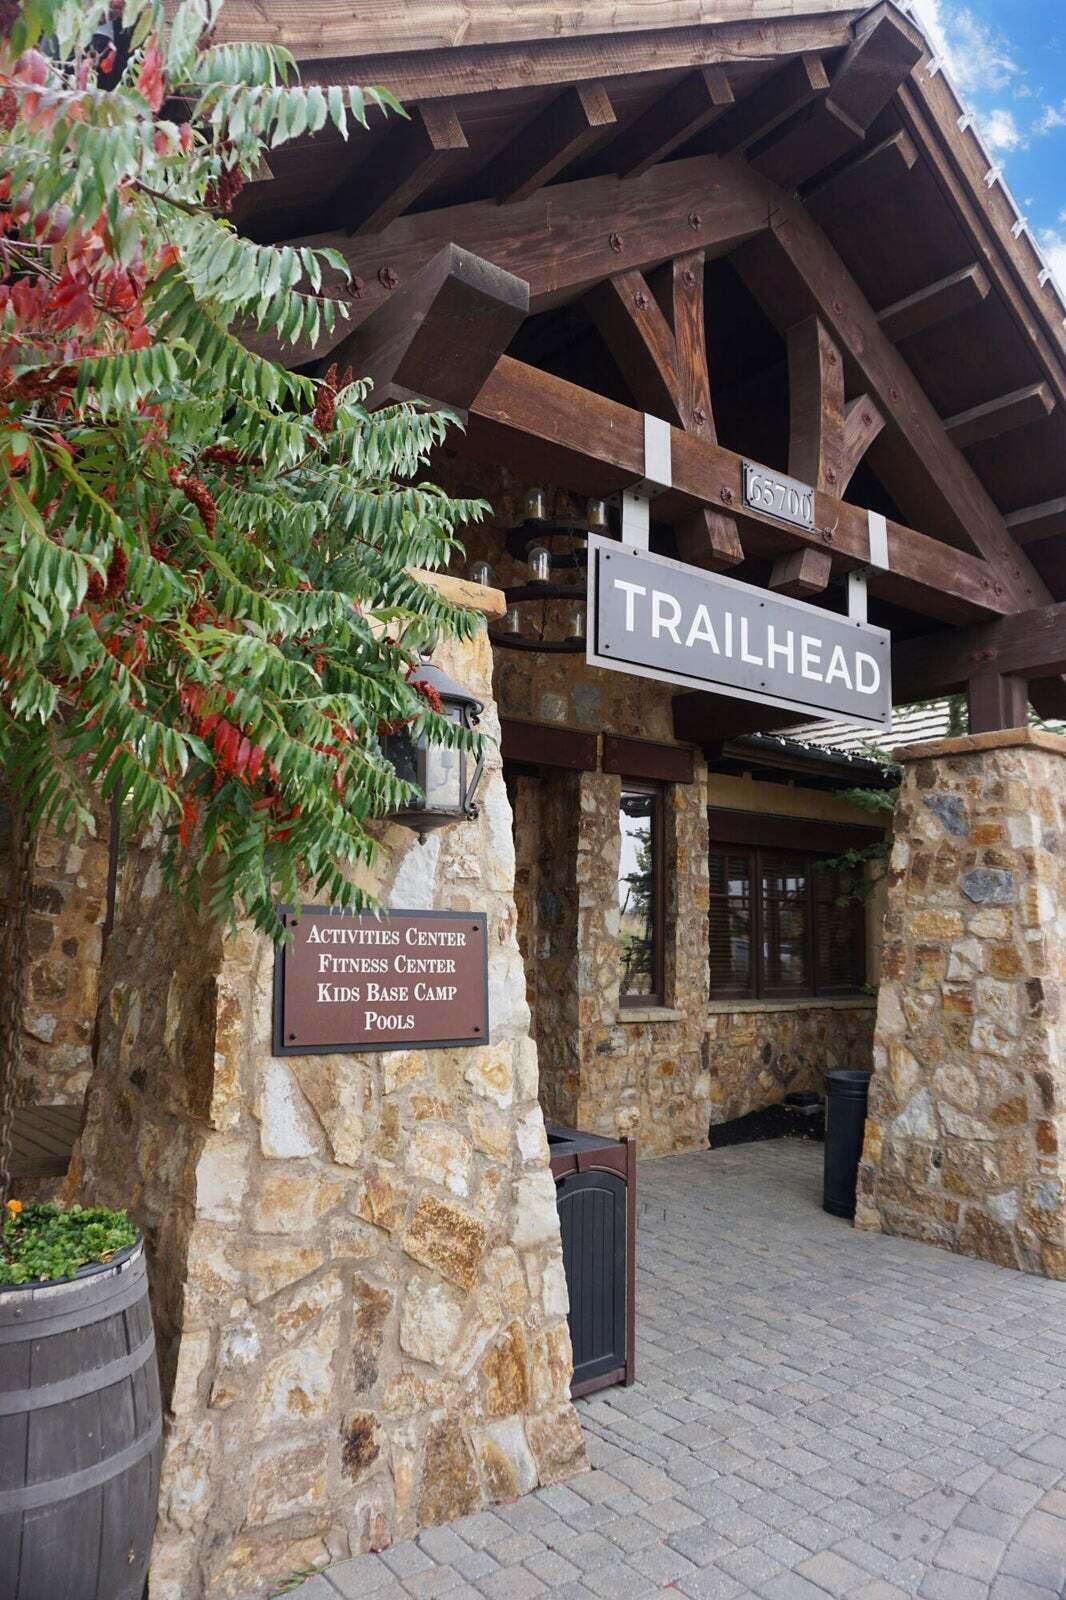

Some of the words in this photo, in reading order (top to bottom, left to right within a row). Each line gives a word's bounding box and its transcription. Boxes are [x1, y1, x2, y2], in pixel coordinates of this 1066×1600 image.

[750, 475, 811, 520] 65700
[613, 579, 881, 695] TRAILHEAD
[306, 925, 400, 945] ACTIVITIES
[405, 928, 466, 947] CENTER
[318, 954, 388, 973] FITNESS
[394, 955, 456, 973] CENTER
[317, 983, 360, 1002] KIDS
[366, 983, 409, 1002] BASE
[414, 983, 457, 1001] CAMP
[364, 1011, 415, 1030] POOLS
